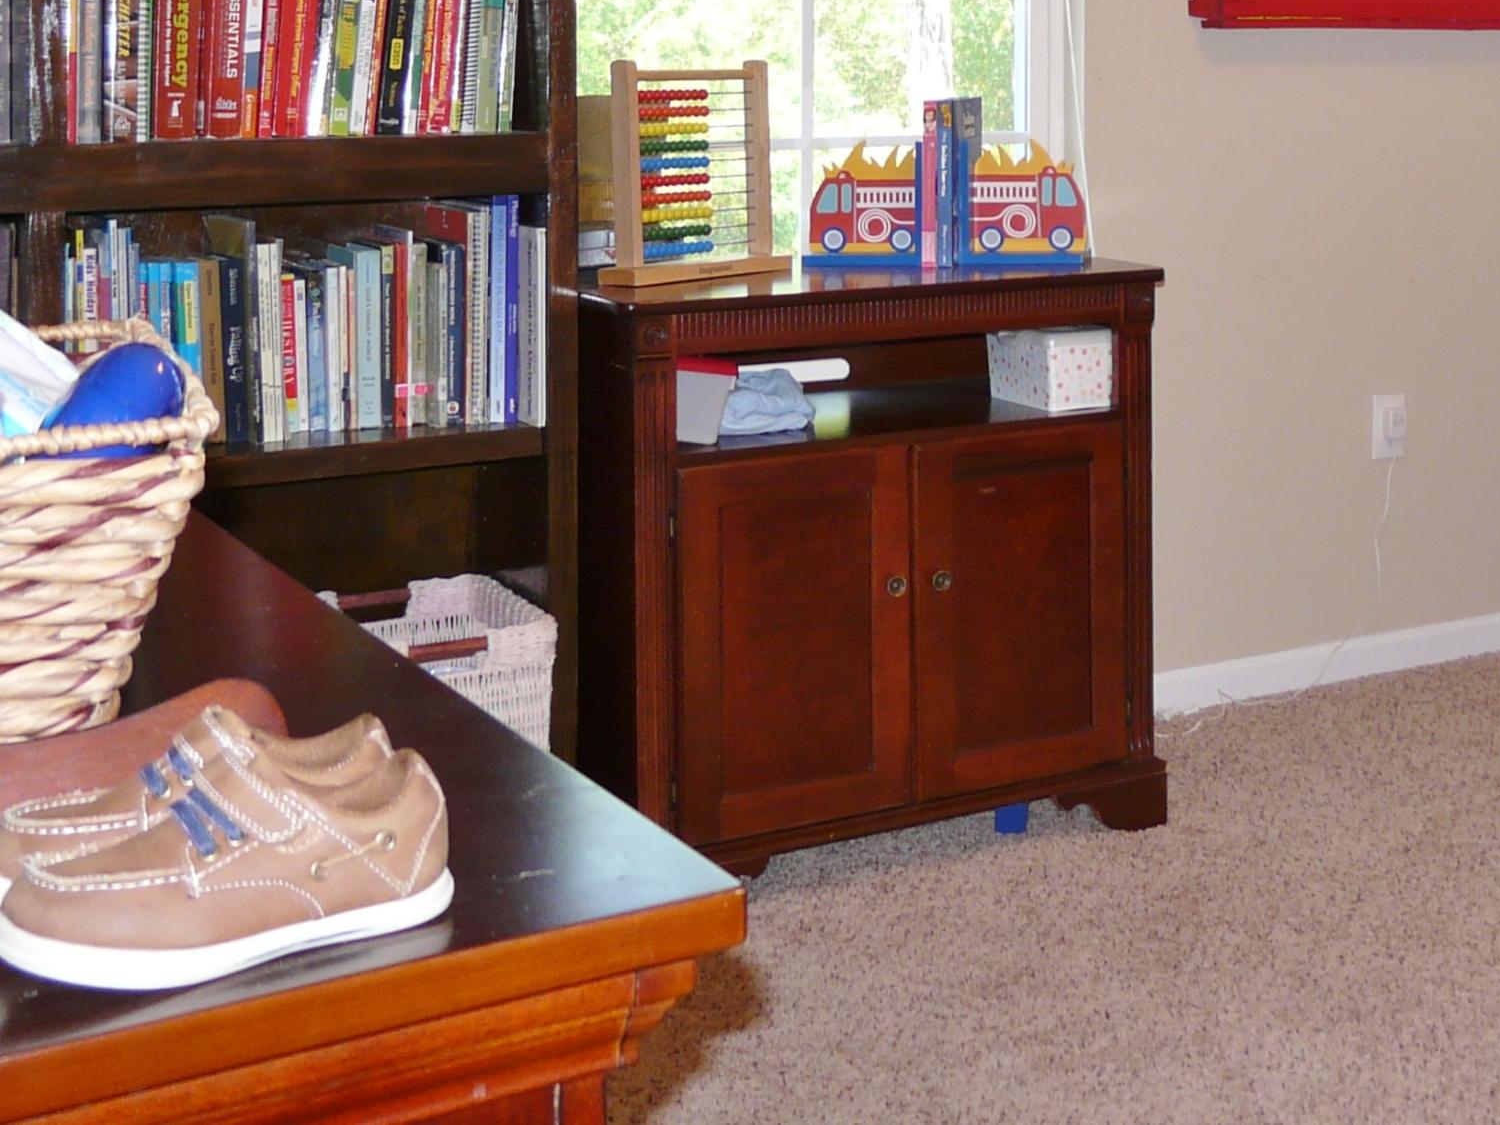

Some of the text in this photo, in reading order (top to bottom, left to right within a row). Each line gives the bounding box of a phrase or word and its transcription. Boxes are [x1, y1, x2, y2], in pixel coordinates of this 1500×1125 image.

[86, 255, 95, 313] Kids' Holiday
[227, 326, 244, 383] Falling Up
[282, 320, 295, 386] HISTORY
